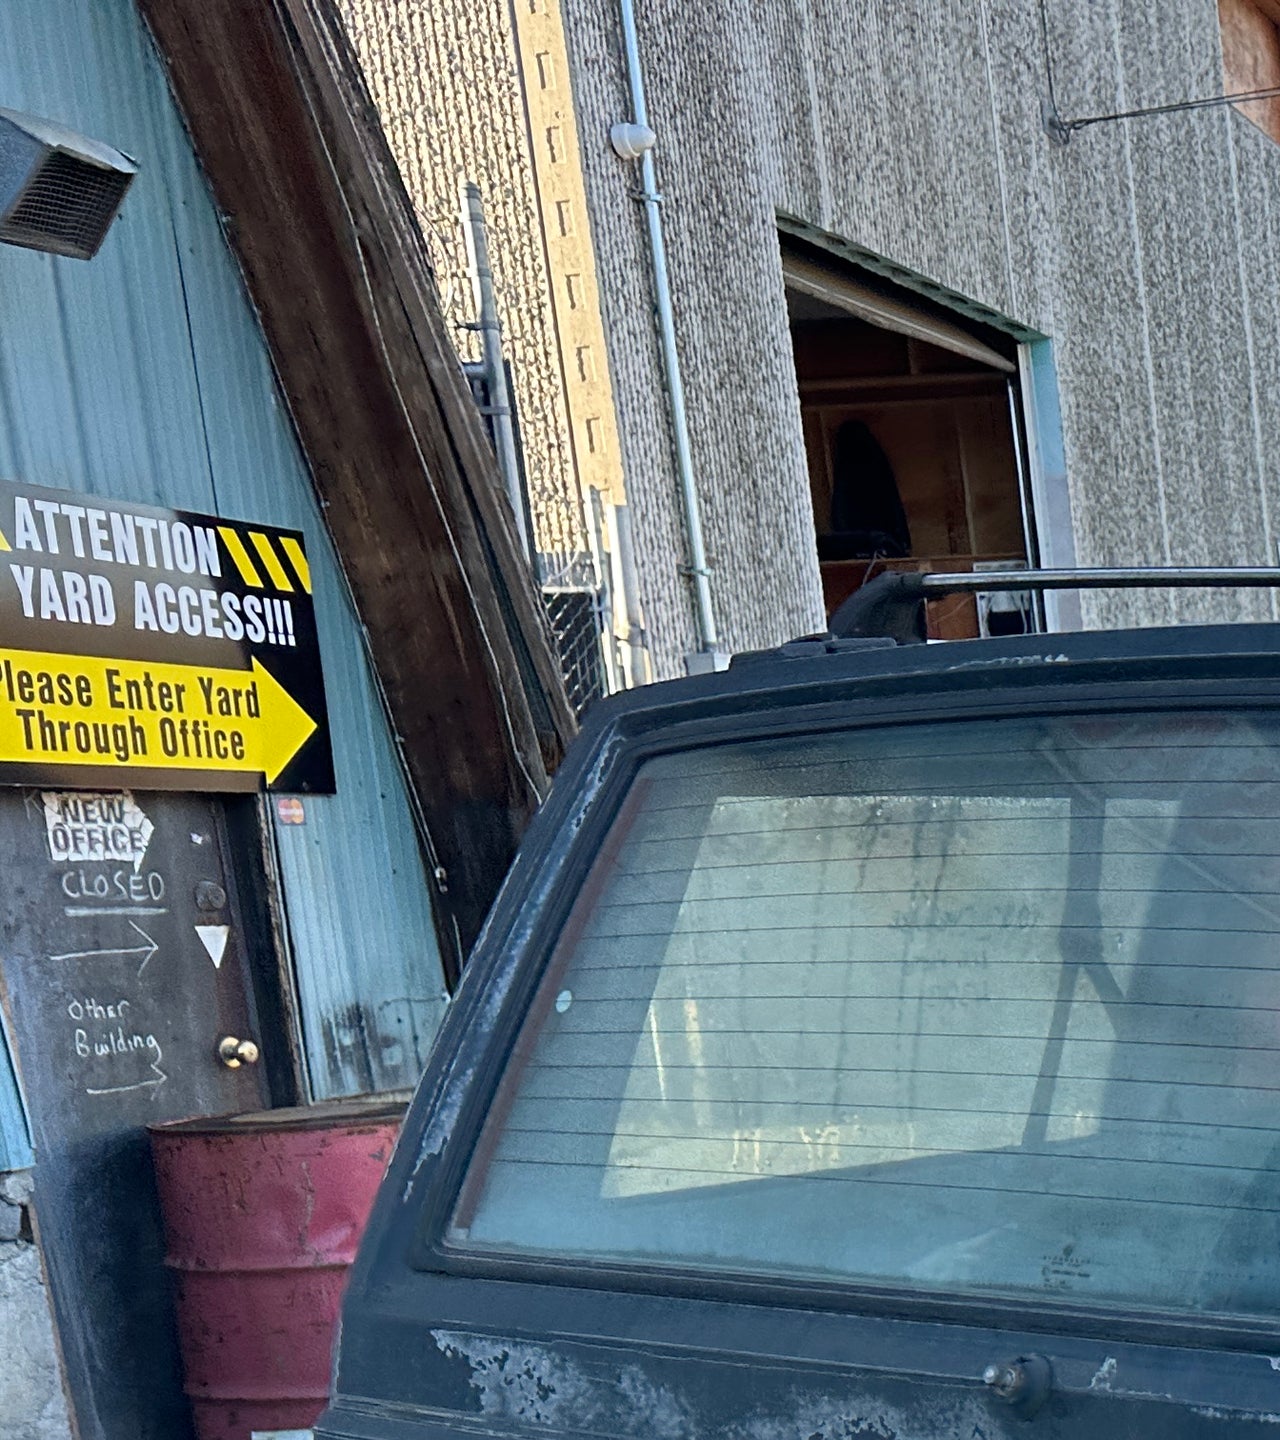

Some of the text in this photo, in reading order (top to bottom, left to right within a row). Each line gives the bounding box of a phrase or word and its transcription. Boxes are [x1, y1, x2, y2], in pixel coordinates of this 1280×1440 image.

[14, 496, 222, 577] ATTENTION
[10, 564, 296, 647] YARD ACCESS!!!
[0, 660, 260, 718] lease Enter Yard
[16, 708, 245, 762] Through Office
[58, 798, 124, 823] NEW
[52, 822, 143, 852] OFFICE
[62, 870, 164, 900] CLOSED
[75, 1029, 162, 1065] Building
